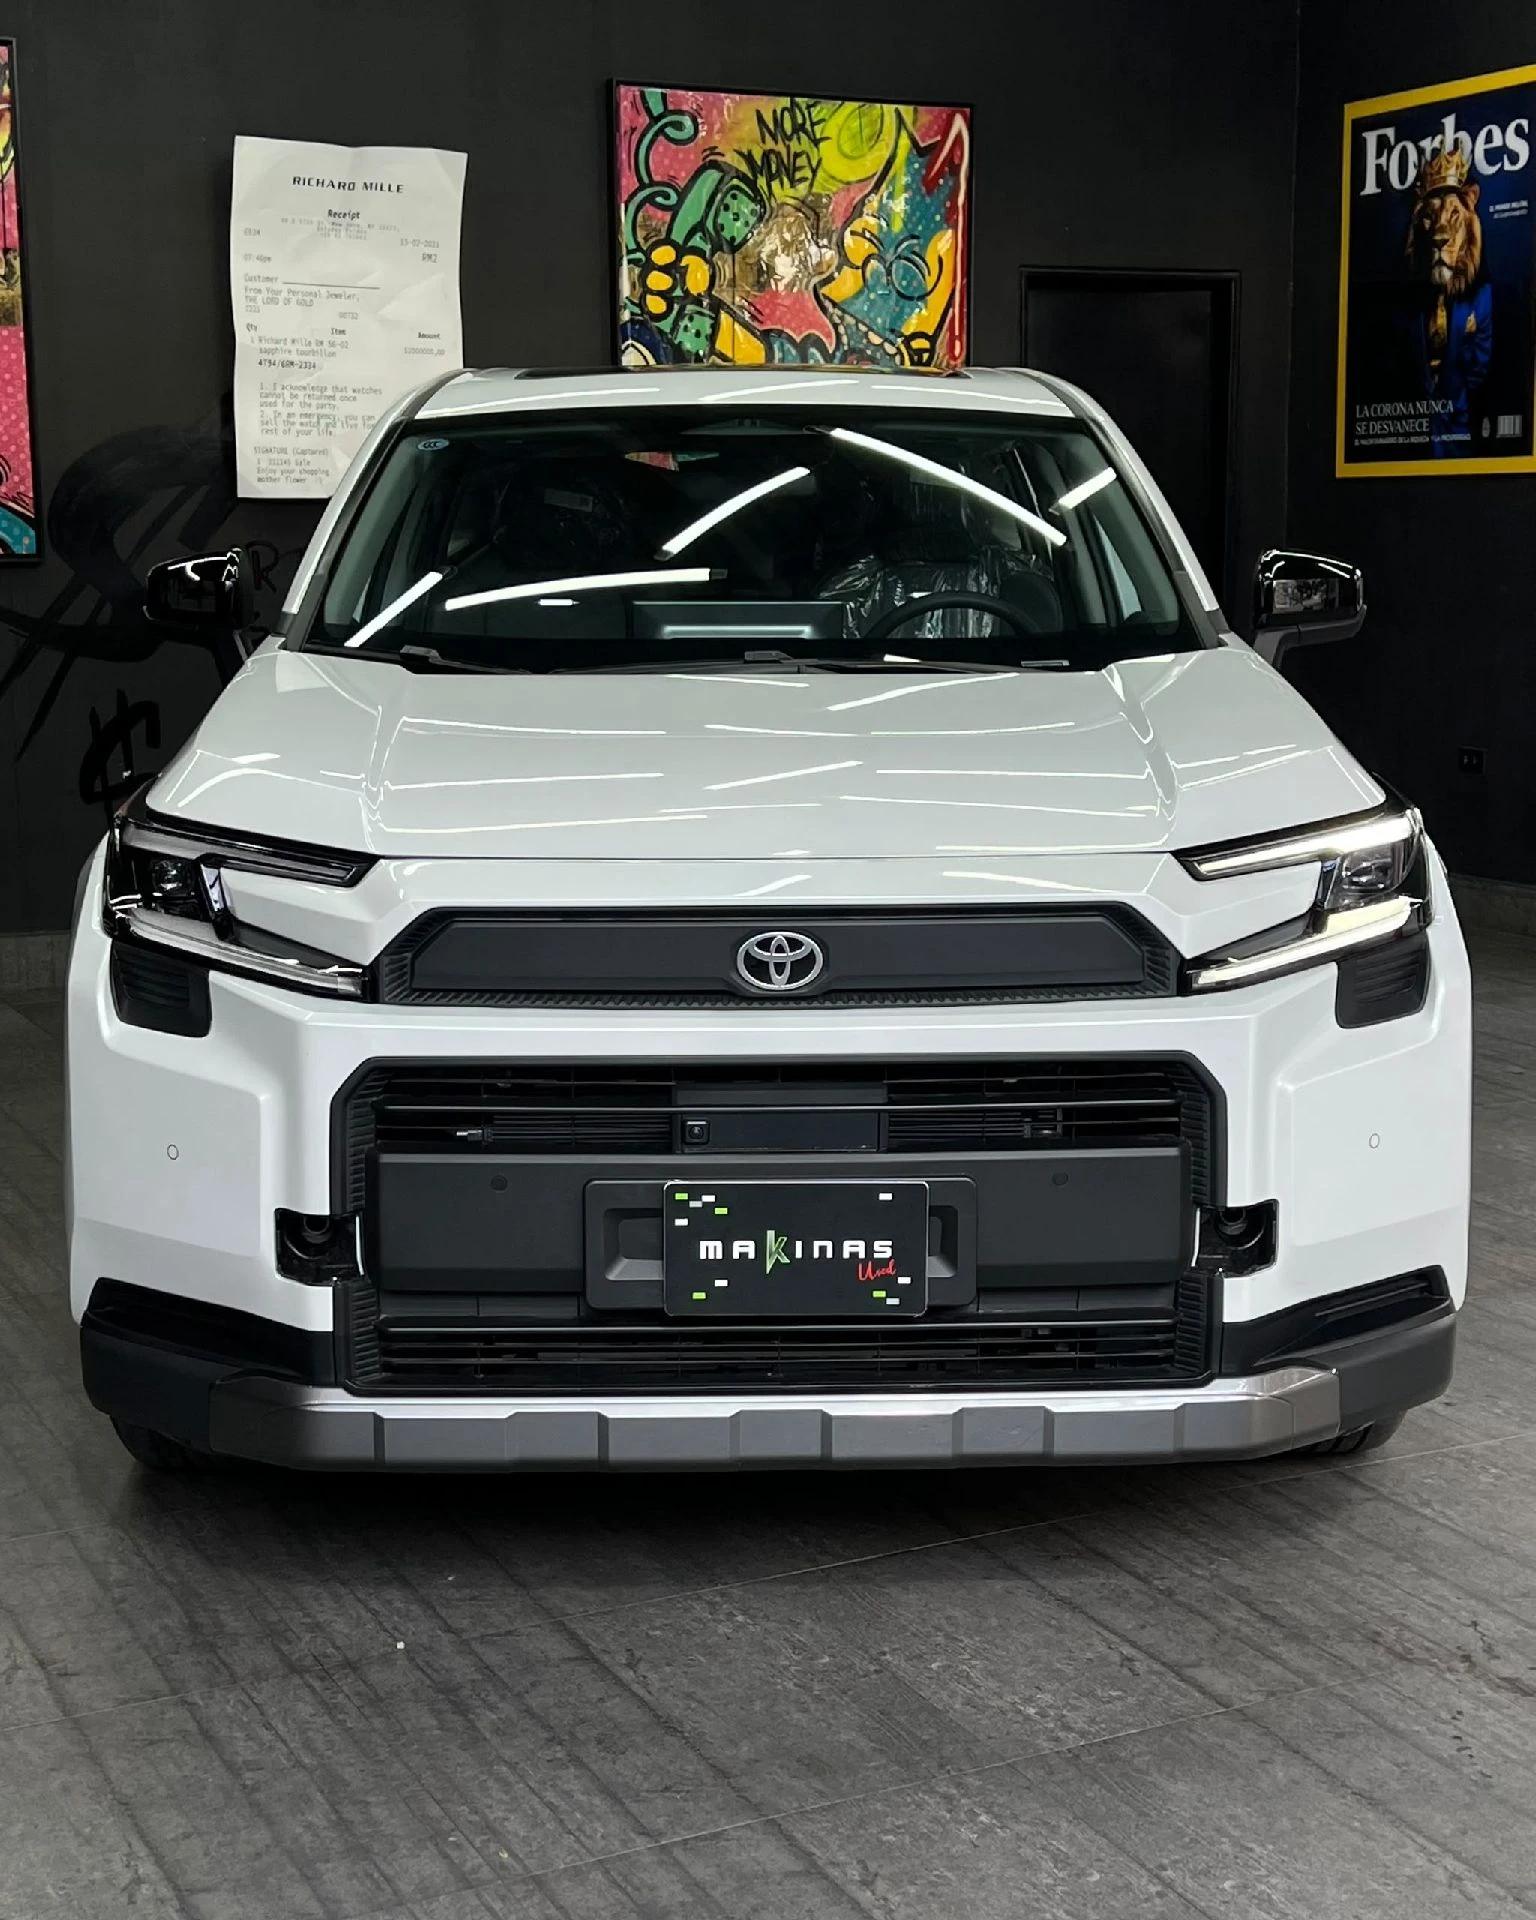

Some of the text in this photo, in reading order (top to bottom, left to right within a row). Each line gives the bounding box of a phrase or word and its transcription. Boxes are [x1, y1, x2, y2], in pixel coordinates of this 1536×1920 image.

[1360, 113, 1530, 196] Forbes
[292, 176, 404, 194] RICHARD MILLE
[327, 209, 360, 222] Receipt
[244, 273, 279, 284] Customer
[244, 286, 262, 295] From
[265, 287, 283, 297] Your
[287, 288, 322, 299] Personal
[245, 296, 258, 304] THE
[283, 297, 294, 306] OF
[246, 323, 258, 333] Qty
[330, 328, 346, 336] Item
[258, 336, 287, 346] Richard
[291, 337, 312, 348] Mille
[259, 348, 336, 358] sapphire tourbillon
[281, 383, 328, 394] acknowledge
[332, 385, 348, 394] that
[352, 385, 383, 396] watches
[260, 391, 357, 403] cannot be returned once
[260, 400, 278, 409] used
[282, 400, 295, 409] for
[299, 400, 312, 410] the
[1356, 399, 1454, 418] LA CORONA NUNCA
[283, 419, 296, 428] the
[1355, 418, 1430, 435] SE DESVANECE
[260, 428, 279, 437] rest
[282, 428, 292, 437] of
[296, 430, 313, 439] your
[257, 467, 330, 478] Enjoy your shopping
